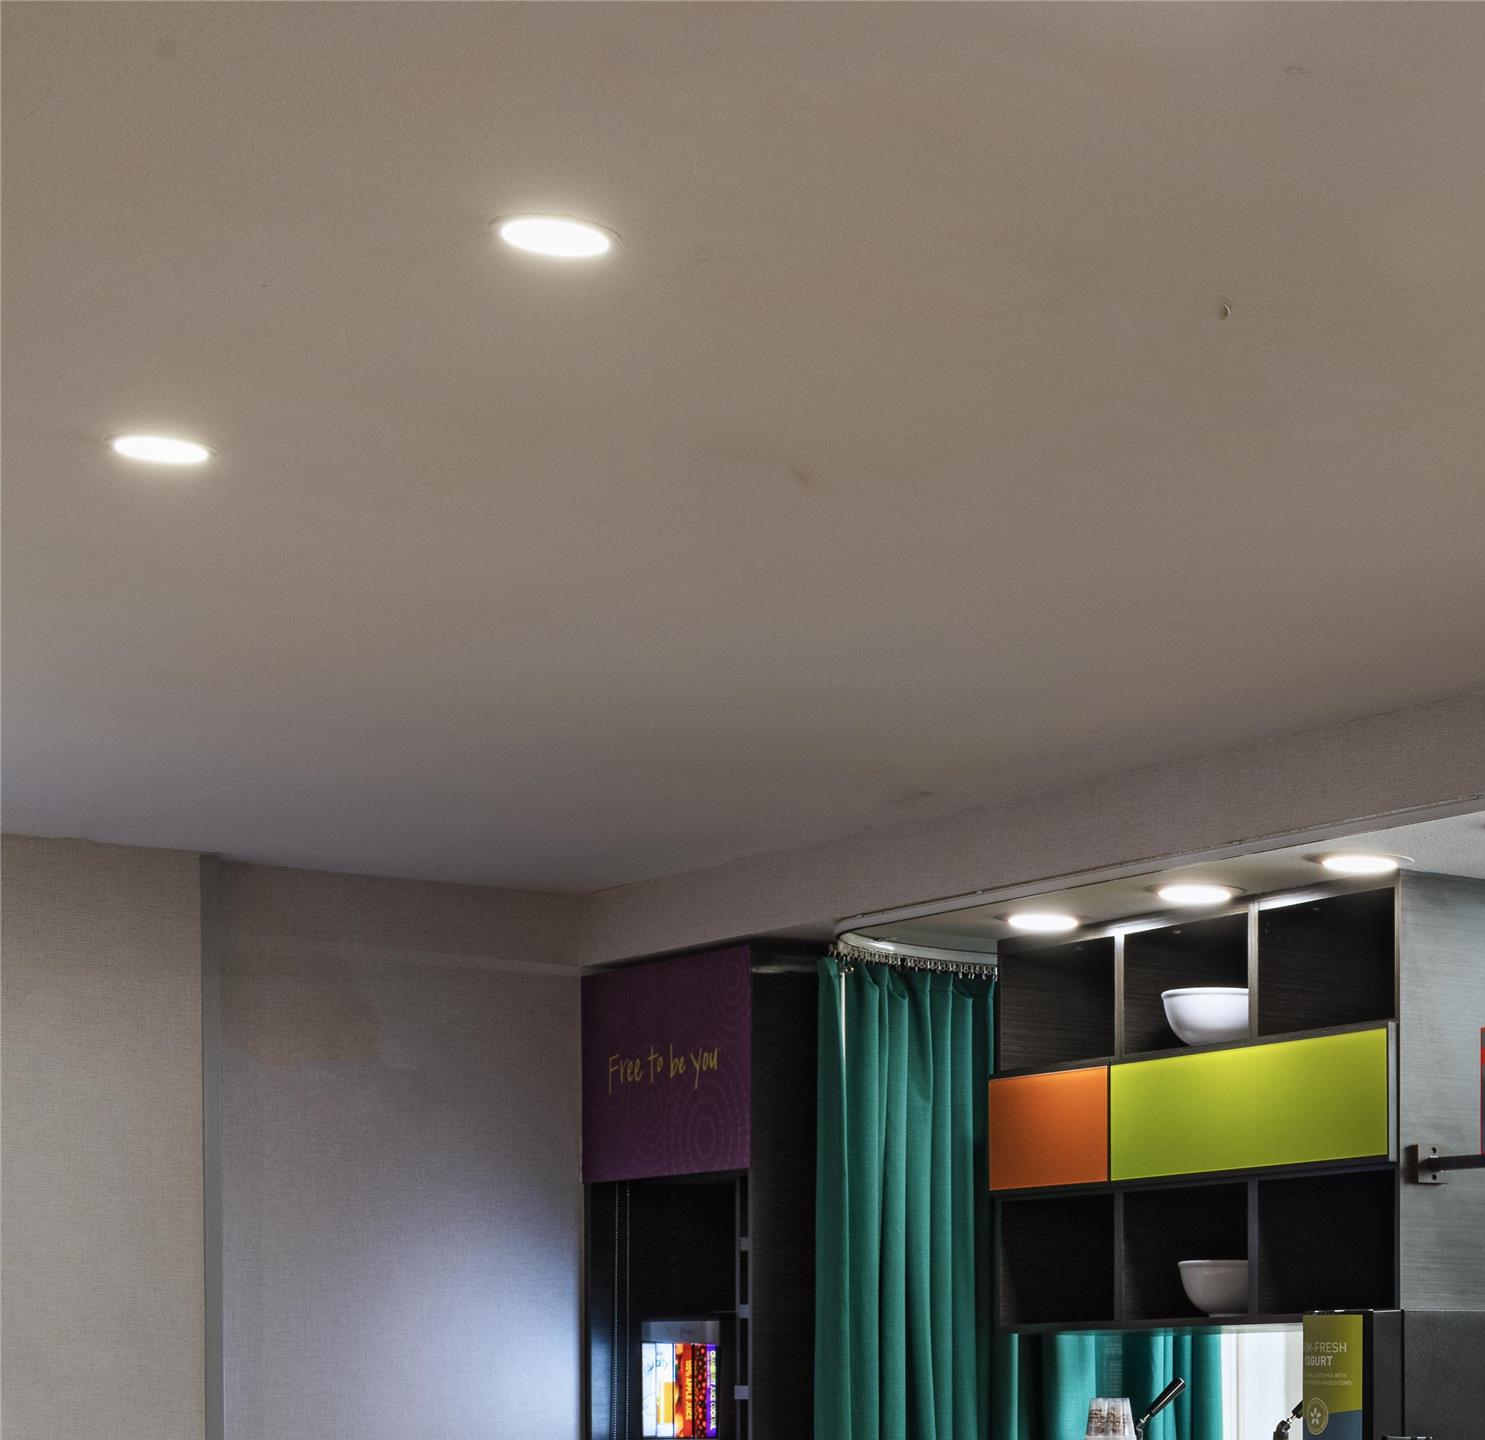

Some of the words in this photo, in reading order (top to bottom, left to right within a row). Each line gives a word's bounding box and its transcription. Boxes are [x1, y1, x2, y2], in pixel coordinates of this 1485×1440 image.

[608, 1053, 644, 1096] Free
[647, 1045, 664, 1083] to
[669, 1043, 686, 1079] be
[690, 1047, 719, 1091] you
[1305, 1342, 1347, 1353] M-FRESH
